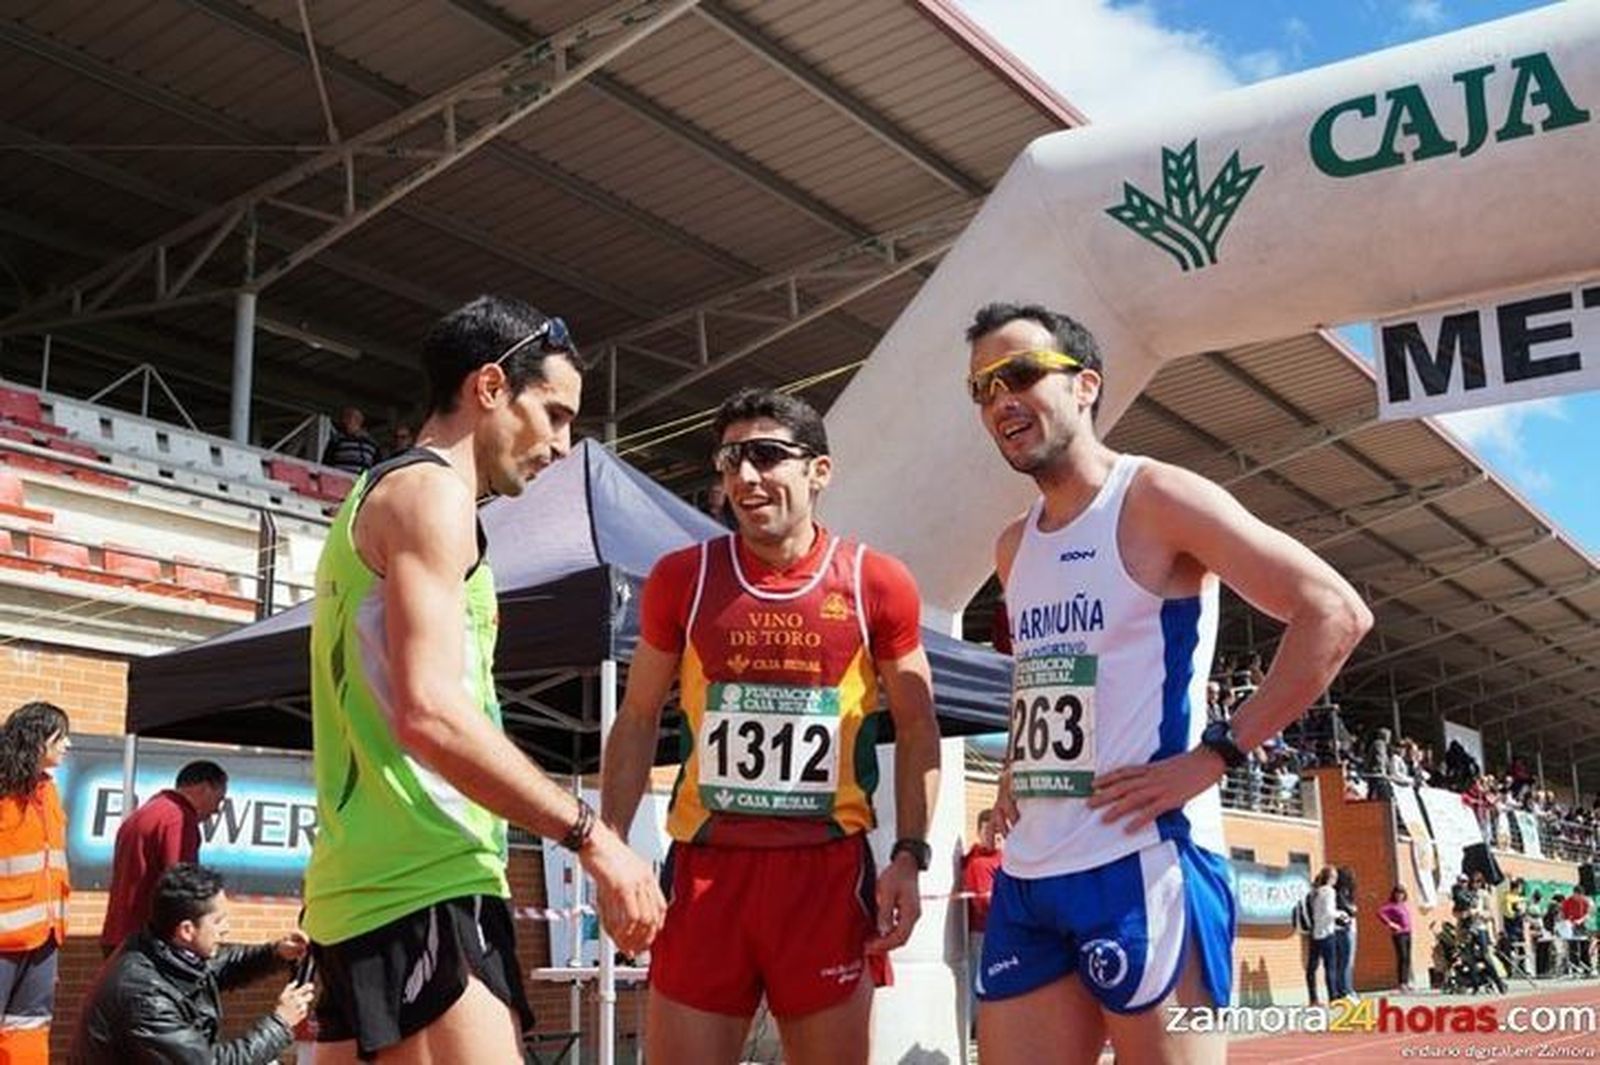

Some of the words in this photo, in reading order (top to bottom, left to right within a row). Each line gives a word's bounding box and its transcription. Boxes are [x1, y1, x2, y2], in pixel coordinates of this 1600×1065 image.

[1310, 52, 1590, 177] CAJA
[730, 631, 757, 646] DE
[761, 631, 821, 647] TORO
[749, 613, 803, 627] VINO
[1020, 593, 1104, 641] ARMUÑA
[708, 719, 831, 782] 1312
[92, 787, 317, 848] PWER
[738, 793, 770, 807] CAJA
